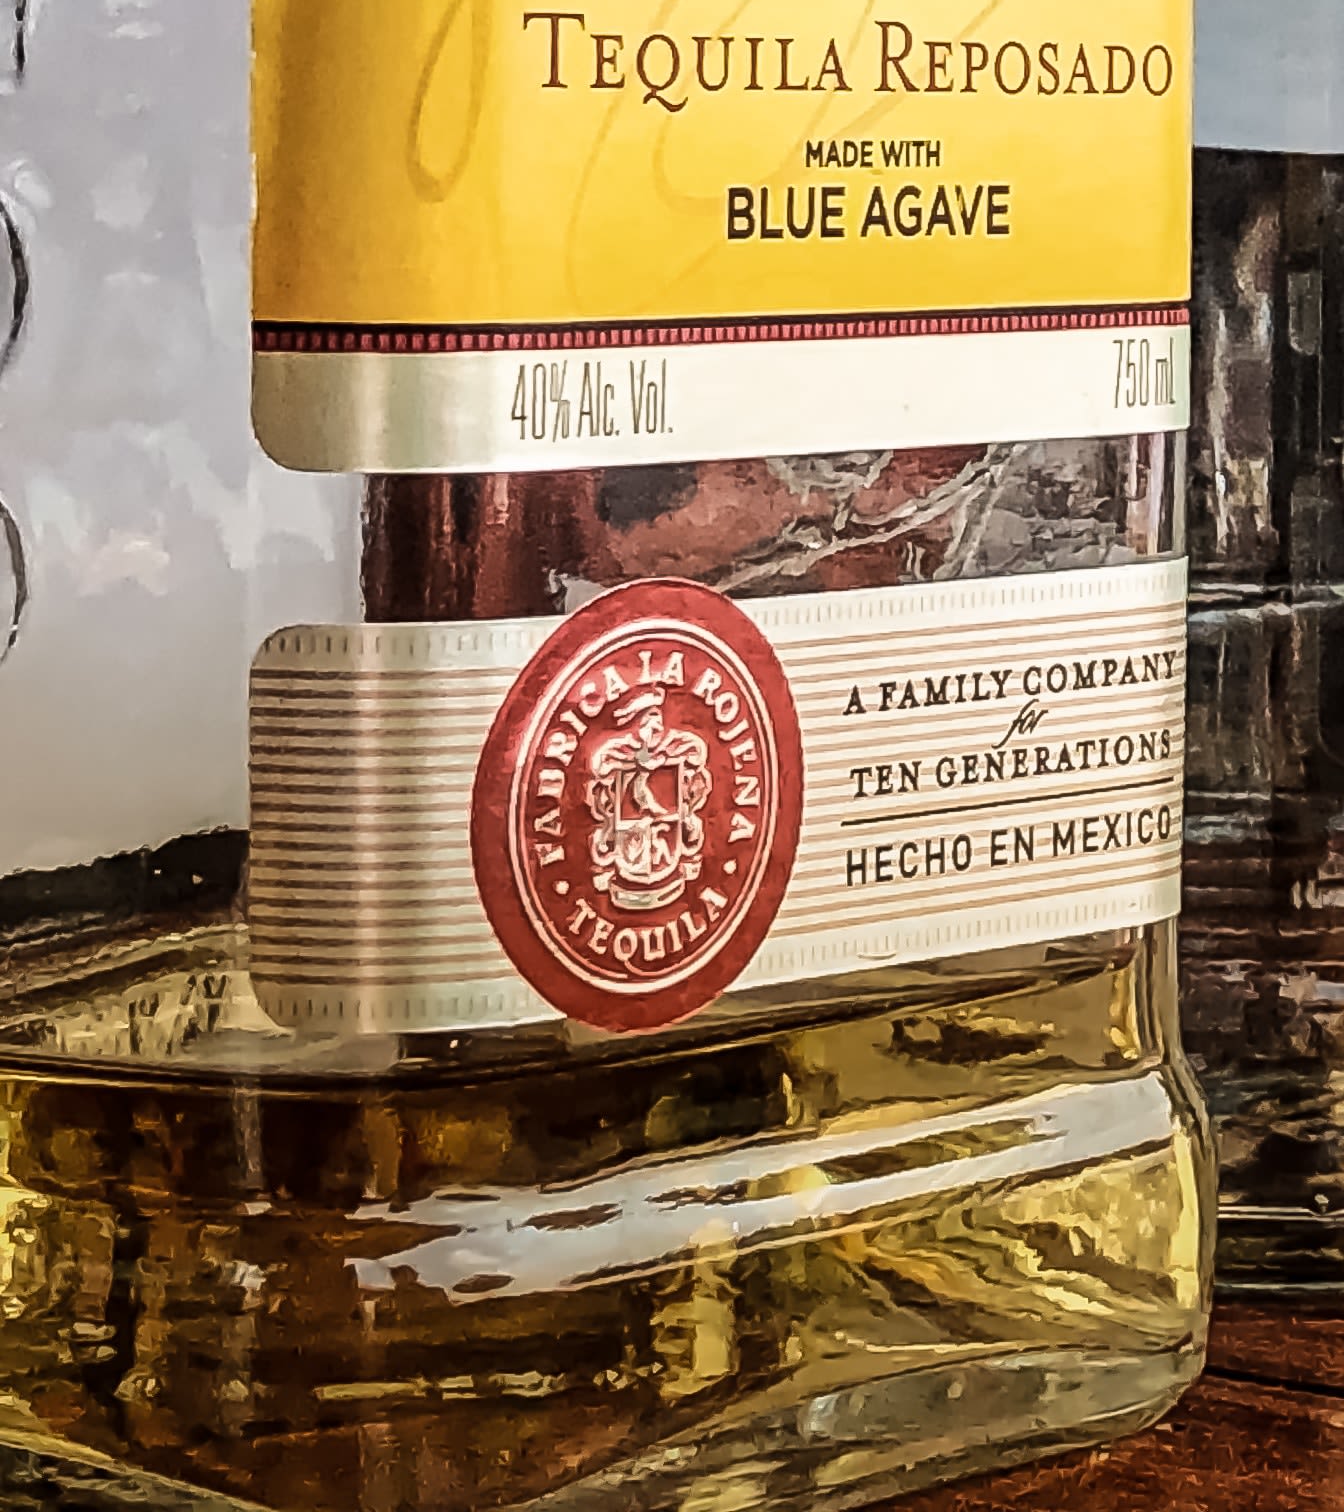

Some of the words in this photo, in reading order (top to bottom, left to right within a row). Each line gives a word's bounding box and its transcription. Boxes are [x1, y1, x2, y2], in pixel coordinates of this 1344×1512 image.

[523, 12, 853, 112] TEQUILA
[874, 20, 1172, 97] REPOSADO
[806, 140, 874, 169] MADE
[880, 139, 941, 168] WITH
[726, 185, 846, 240] BLUE
[860, 184, 1011, 237] AGAVE
[629, 357, 674, 436] Vol.
[1112, 338, 1152, 410] 750
[1155, 339, 1177, 406] ml
[637, 649, 685, 687] LA
[842, 685, 868, 717] A
[879, 670, 1012, 712] FAMILY
[1022, 649, 1179, 695] COMPANY
[991, 699, 1049, 749] for
[851, 757, 921, 799] TEN
[936, 729, 1172, 790] GENERATIONS
[846, 832, 972, 887] HECHO
[990, 825, 1034, 869] EN
[1051, 803, 1171, 859] MEXICO
[567, 886, 729, 964] TEQUILA
